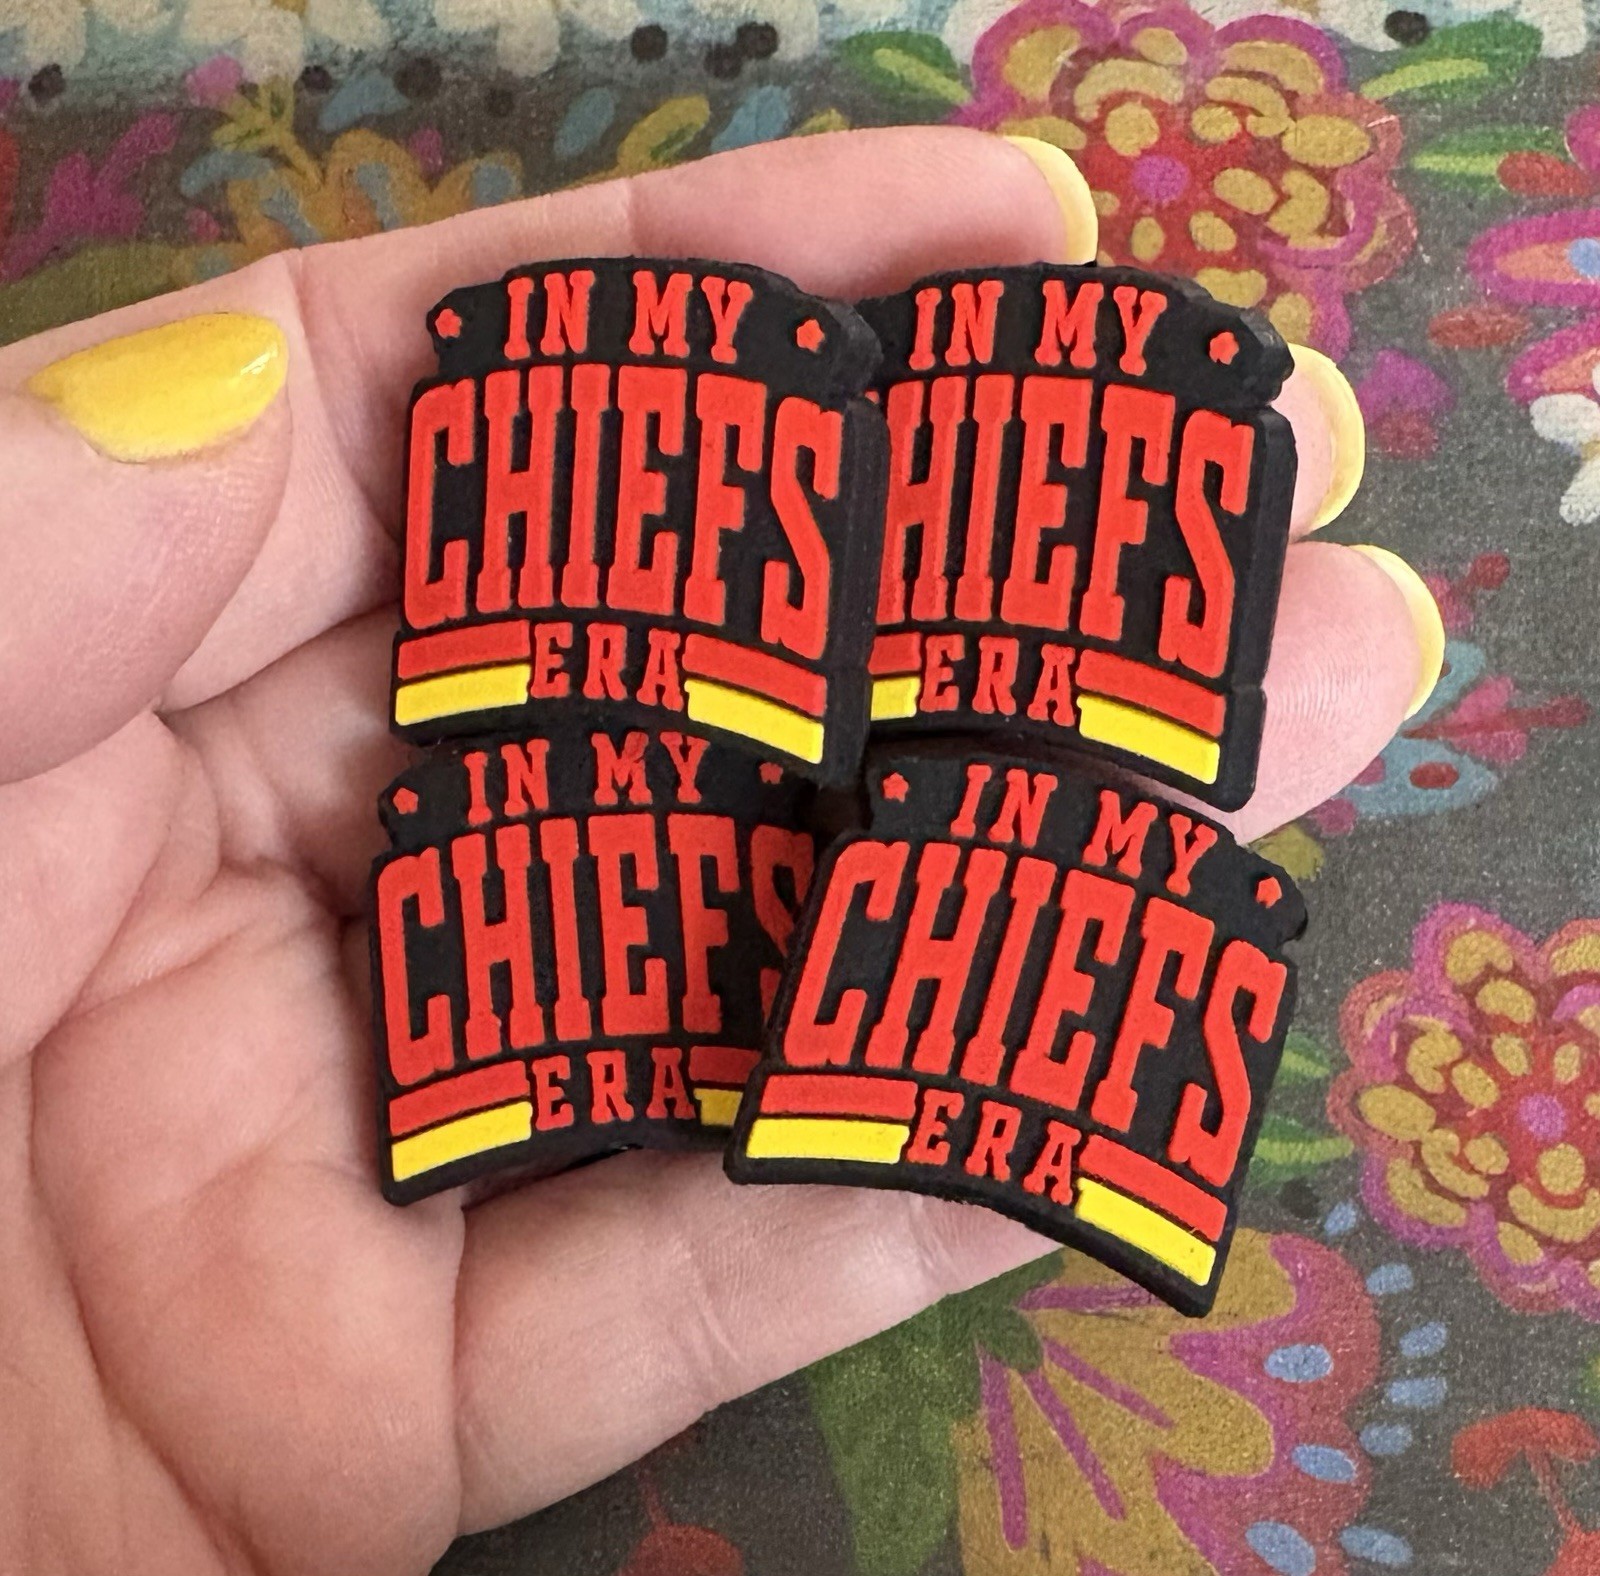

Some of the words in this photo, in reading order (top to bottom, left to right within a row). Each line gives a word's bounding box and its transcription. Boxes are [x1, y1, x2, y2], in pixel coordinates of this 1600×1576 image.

[504, 269, 593, 359] IN
[629, 269, 753, 362] MY
[909, 279, 1003, 369] IN
[1035, 280, 1167, 374] MY
[404, 363, 842, 659] CHIEFS
[866, 374, 1254, 676] HIEFS
[530, 621, 684, 710] ERA
[920, 633, 1075, 725] ERA
[463, 738, 550, 825] IN
[591, 731, 708, 805] MY
[950, 764, 1057, 847] IN
[1081, 789, 1217, 896] MY
[783, 840, 1287, 1187] CHIEFS
[531, 1047, 696, 1131] ERA
[906, 1089, 1081, 1204] ERA
